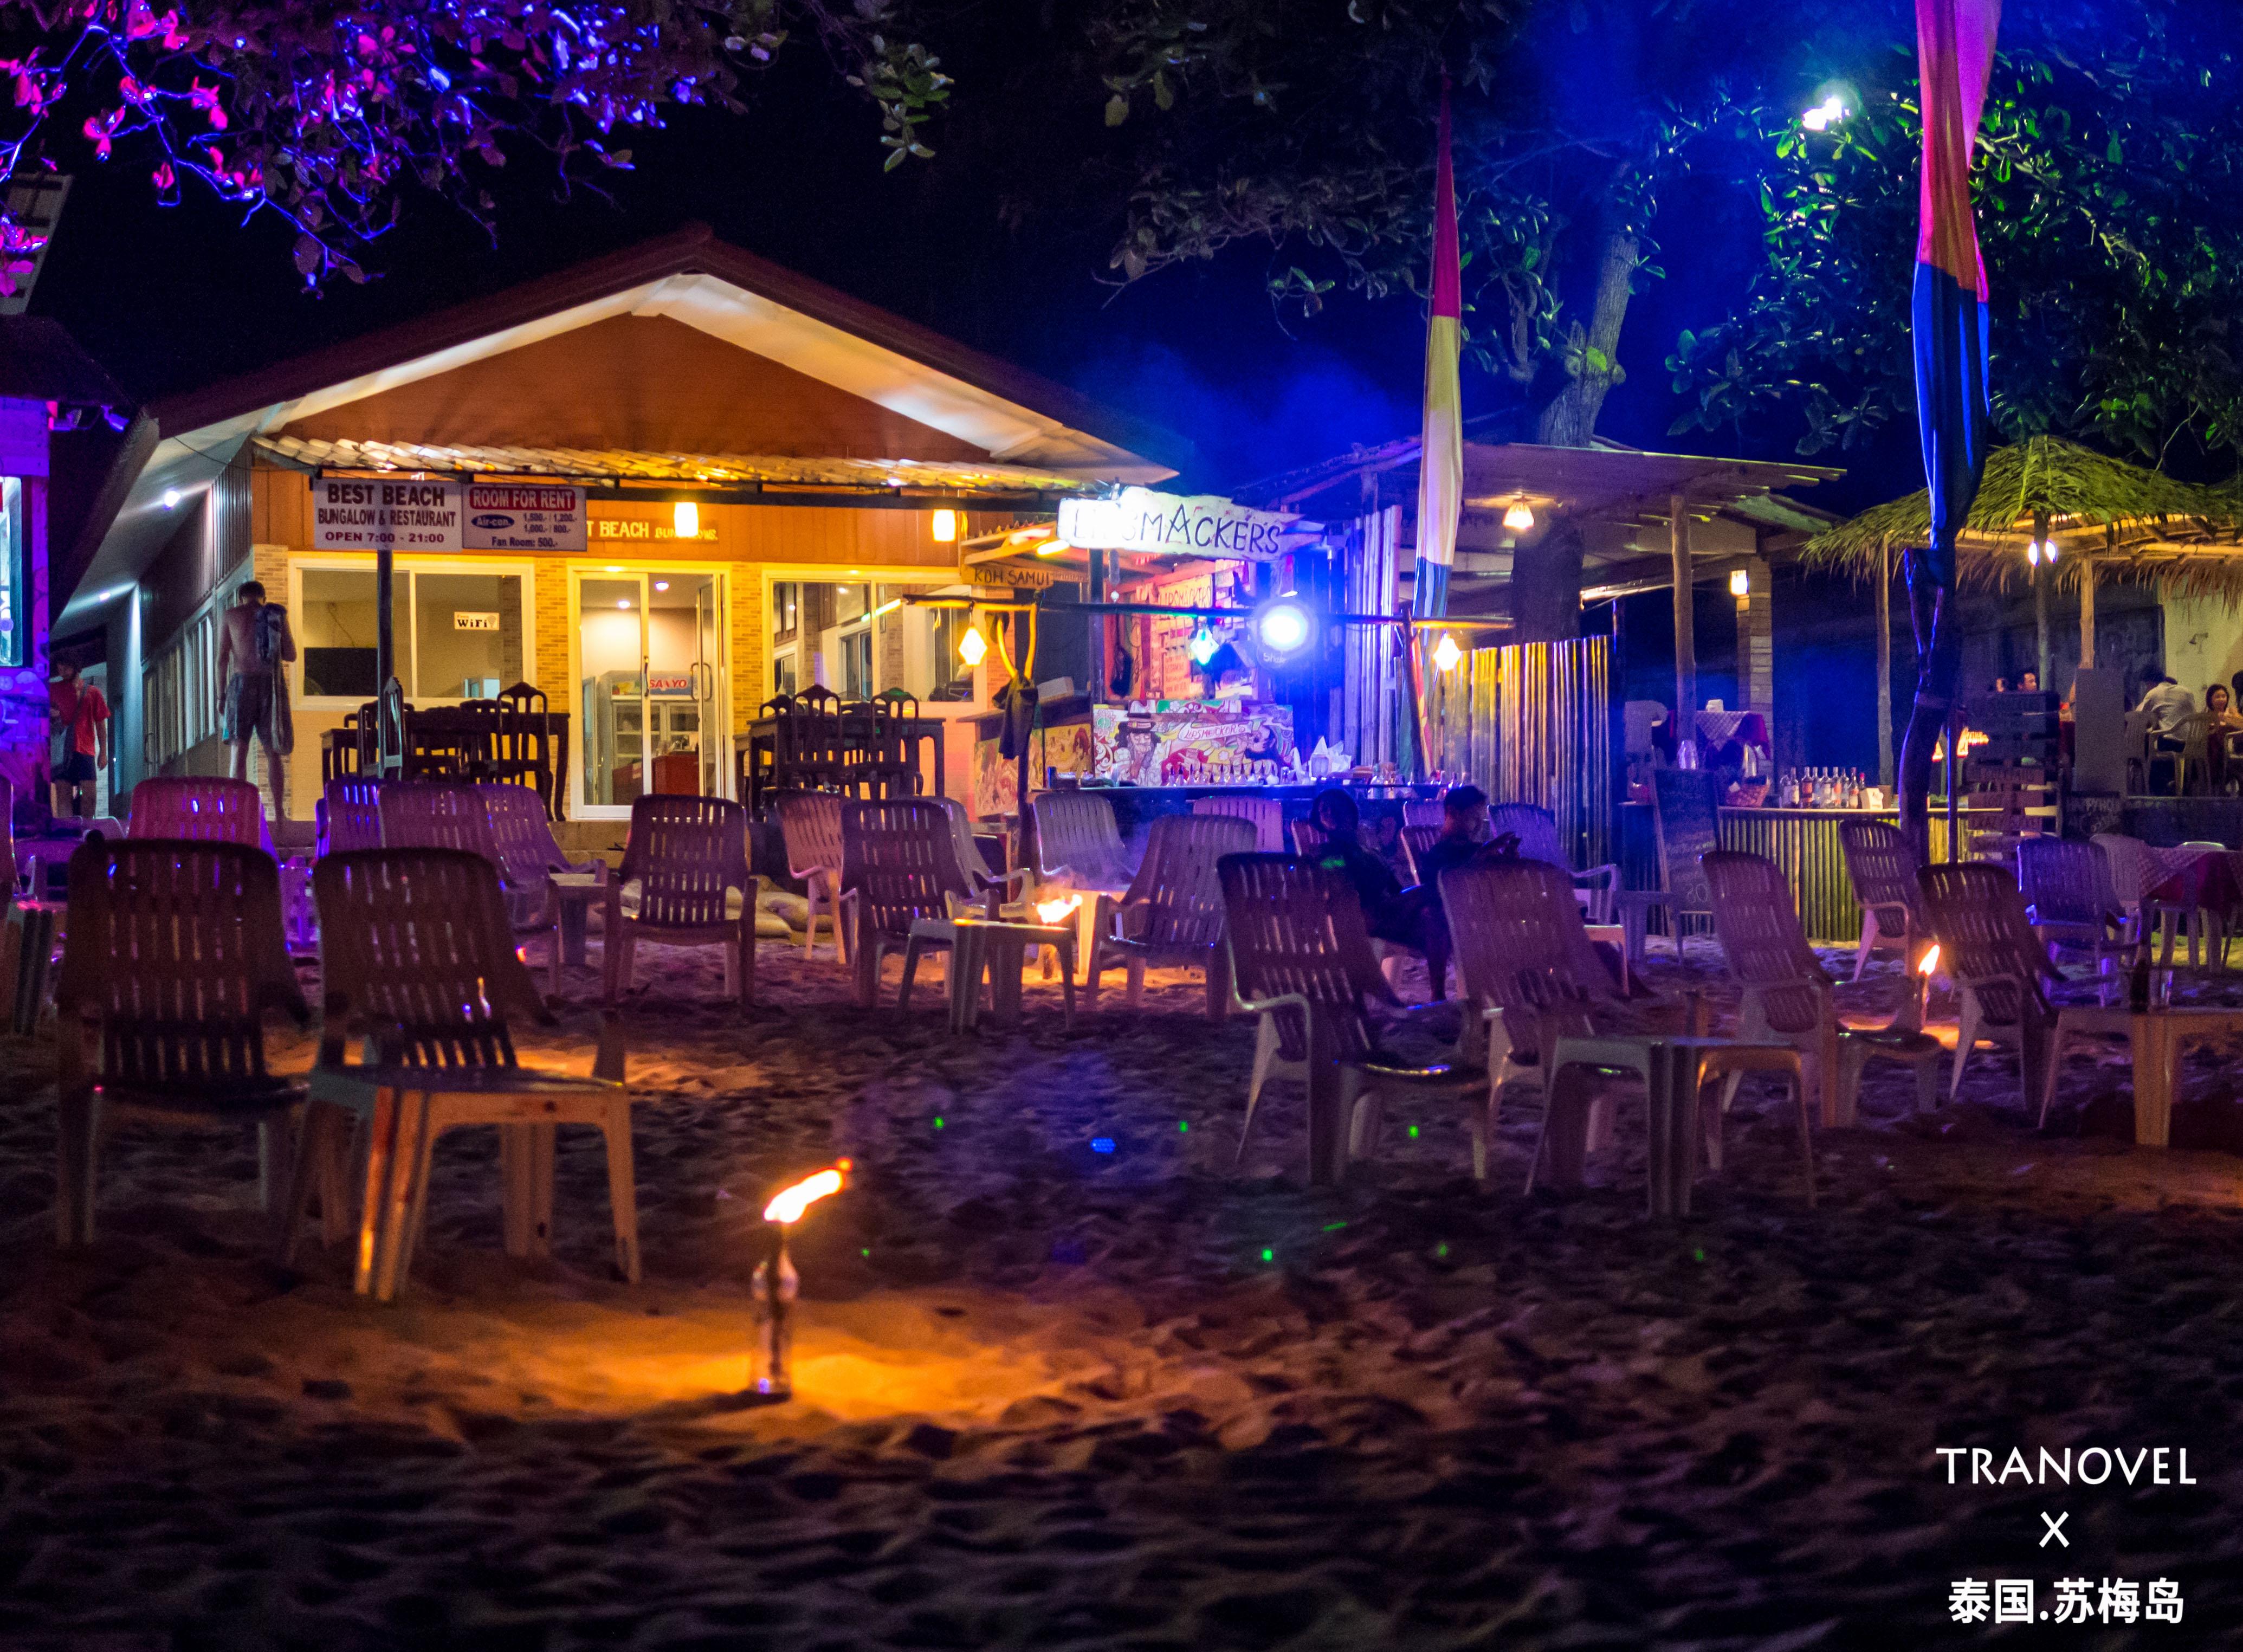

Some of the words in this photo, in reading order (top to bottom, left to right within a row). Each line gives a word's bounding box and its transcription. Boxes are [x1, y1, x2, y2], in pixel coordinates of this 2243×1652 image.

[327, 483, 374, 505] BEST
[382, 485, 445, 507] BEACH
[473, 489, 509, 508] ROOM
[513, 489, 537, 508] FOR
[541, 491, 573, 509] RENT
[318, 508, 376, 525] BUNGALOW
[379, 509, 386, 526] &
[390, 509, 456, 527] RESTAURANT
[325, 531, 363, 541] OPEN
[367, 532, 395, 543] 7:00
[409, 533, 444, 543] 21:00
[599, 520, 650, 539] BEACH
[1073, 504, 1281, 554] LSMACKERS
[492, 536, 507, 546] Fan
[974, 567, 1003, 583] KOH
[1007, 570, 1050, 586] SAMUI
